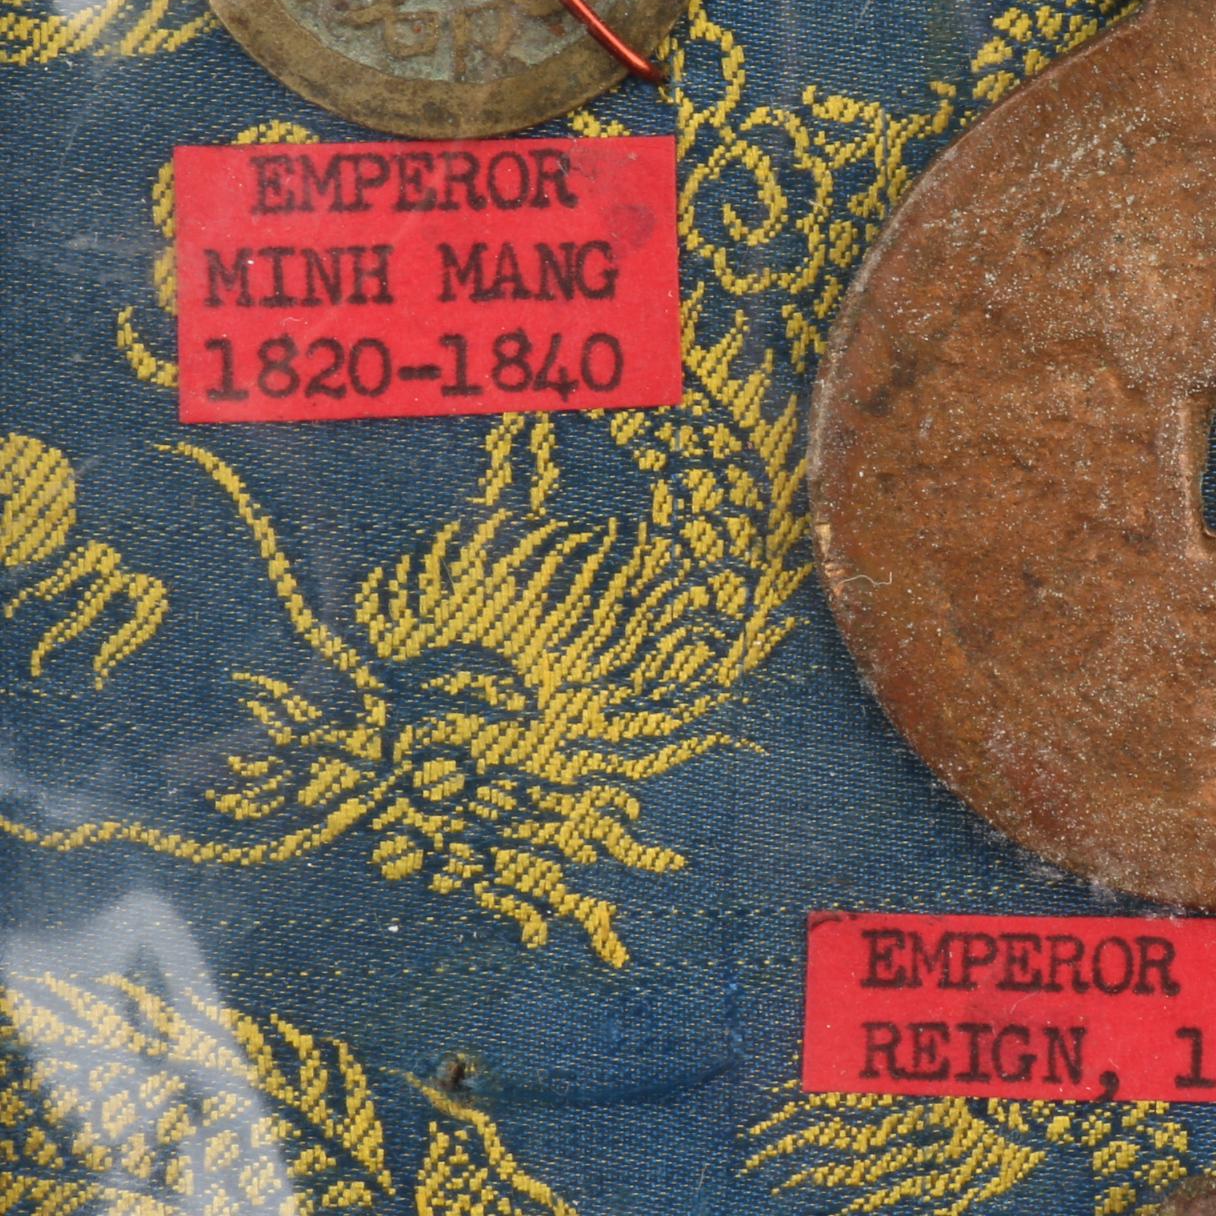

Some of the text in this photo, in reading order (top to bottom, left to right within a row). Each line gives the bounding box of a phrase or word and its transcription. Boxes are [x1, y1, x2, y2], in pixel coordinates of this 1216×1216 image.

[249, 148, 579, 215] EMPEROR
[203, 239, 620, 309] MINH MANG
[204, 328, 625, 402] 1820-1840
[858, 927, 1182, 997] EMPEROR
[858, 1020, 1121, 1102] REIGN,
